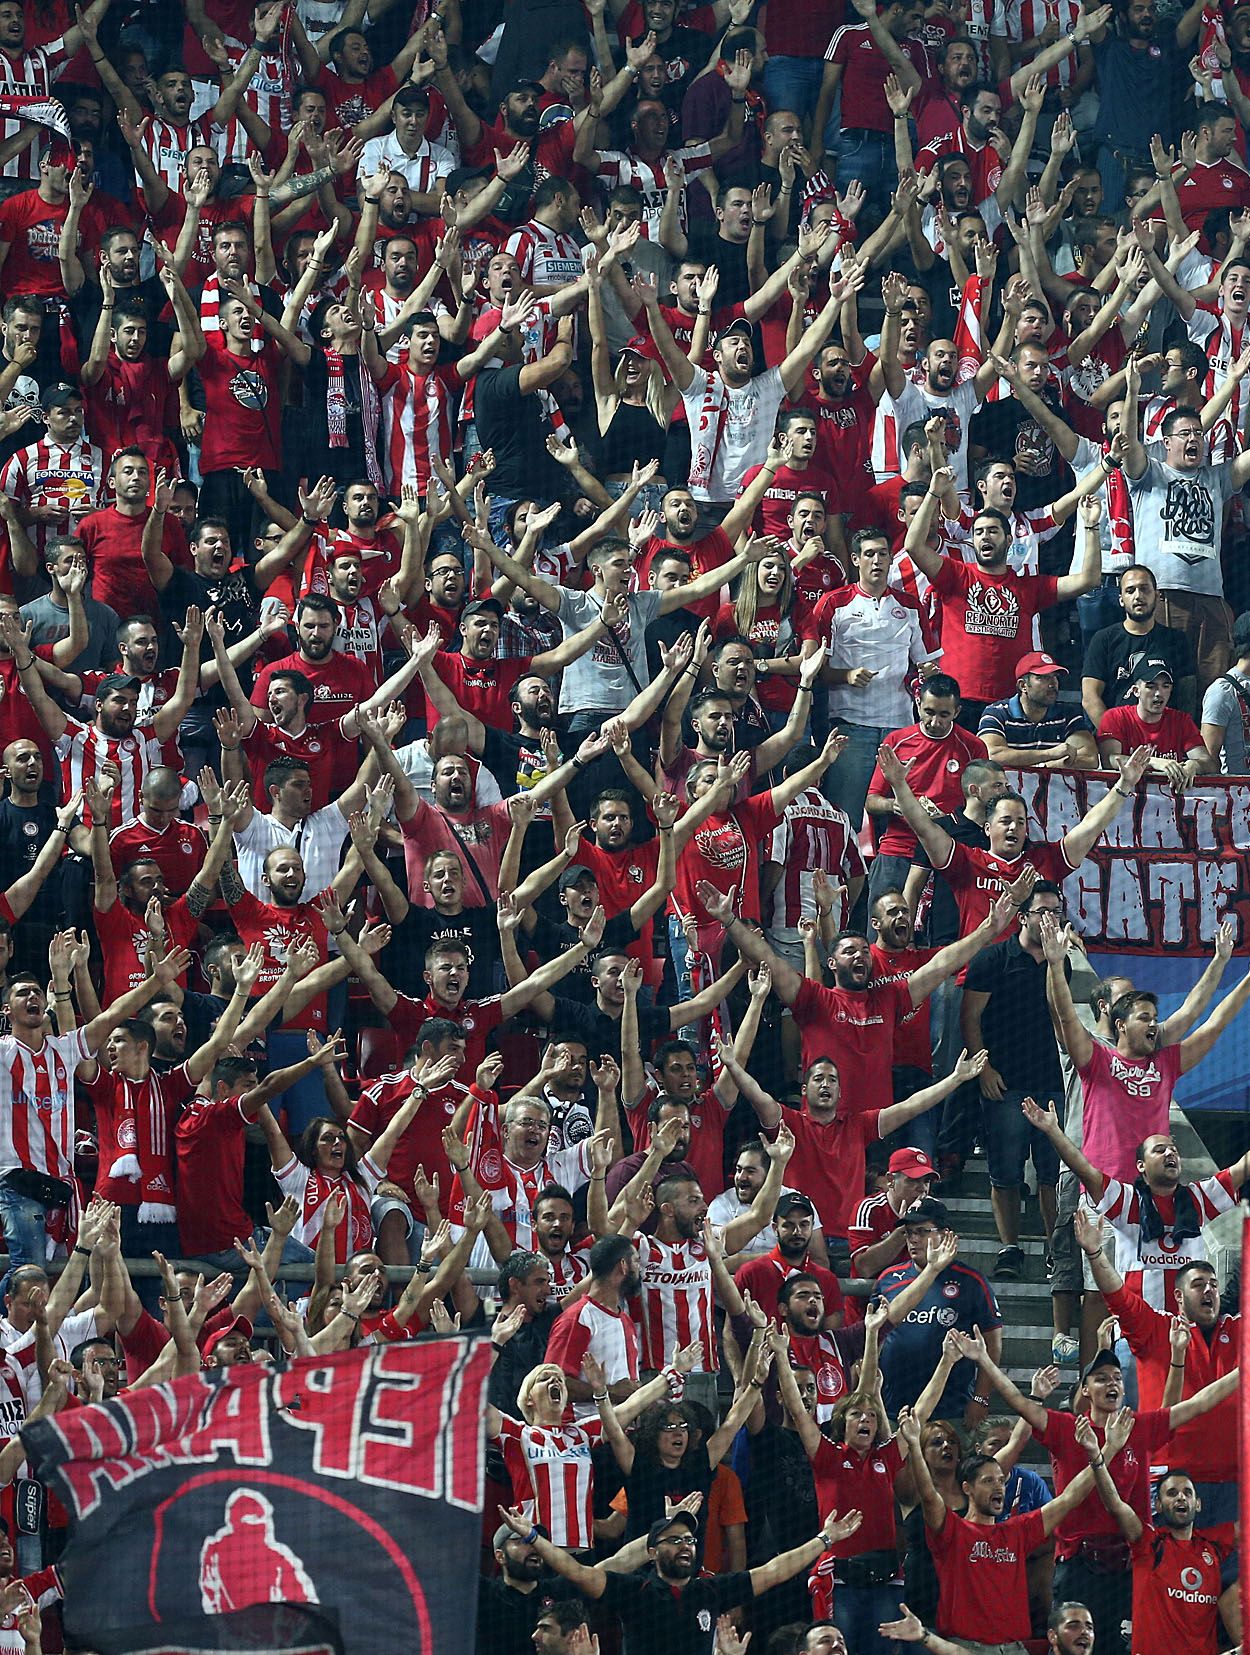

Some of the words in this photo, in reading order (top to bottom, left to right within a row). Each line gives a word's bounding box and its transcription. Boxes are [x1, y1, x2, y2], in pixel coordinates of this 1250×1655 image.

[35, 467, 94, 481] ΕΘΝΟΚΑΡΤΑ
[986, 614, 1019, 629] NORTH
[1062, 857, 1238, 943] GATE
[147, 1183, 170, 1194] adidas
[902, 1306, 936, 1325] cef
[1168, 1587, 1218, 1605] vodafone
